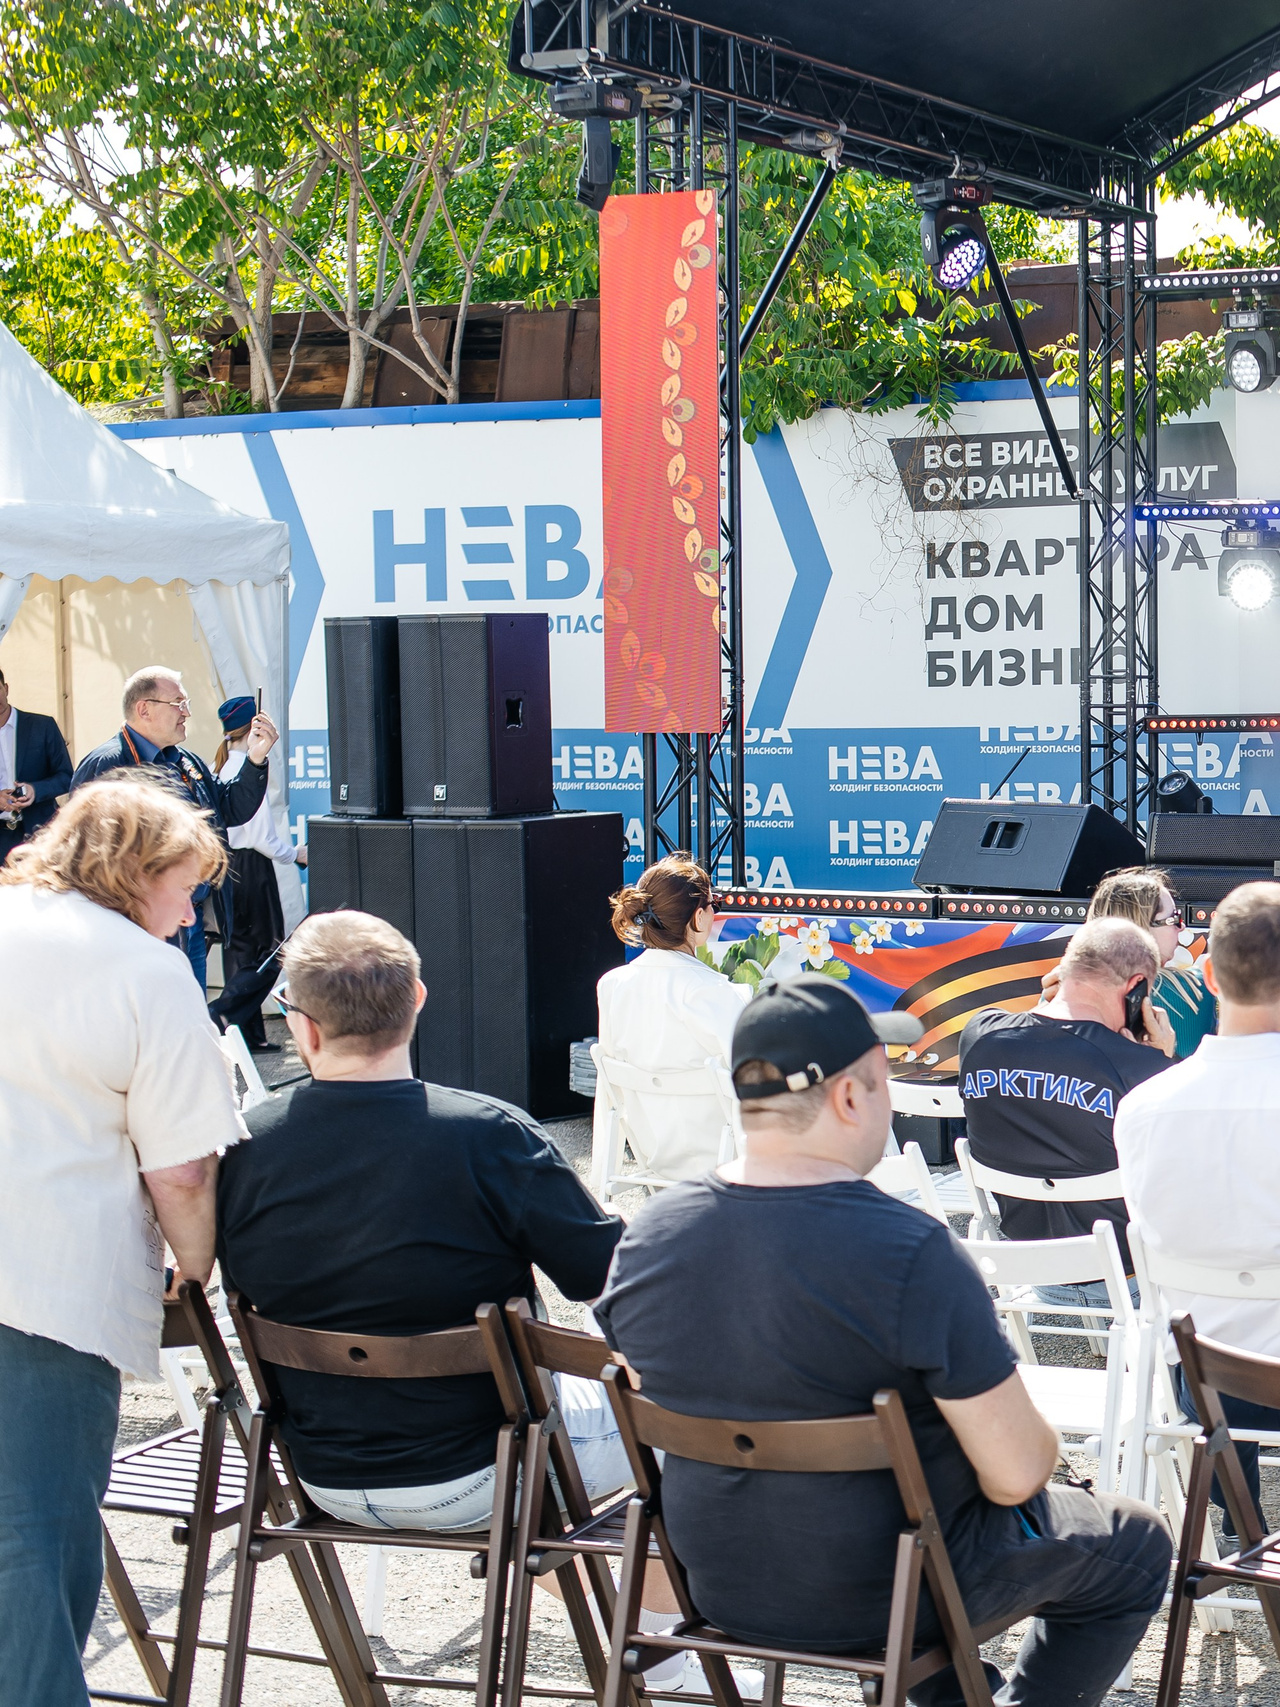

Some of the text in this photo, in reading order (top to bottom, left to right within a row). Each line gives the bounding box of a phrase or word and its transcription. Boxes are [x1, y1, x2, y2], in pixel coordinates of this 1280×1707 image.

[923, 442, 983, 469] ВСЕ
[373, 504, 603, 604] НЕВ
[925, 594, 1044, 640] ДОМ
[828, 745, 943, 780] НЕВА
[980, 745, 1024, 755] ХОЛДИНГ
[829, 783, 943, 793] ХОЛДИНГ БЕЗОПАСНОСТИ
[830, 857, 873, 867] ХОЛДИНГ
[963, 1068, 1115, 1119] АРКТИКА
